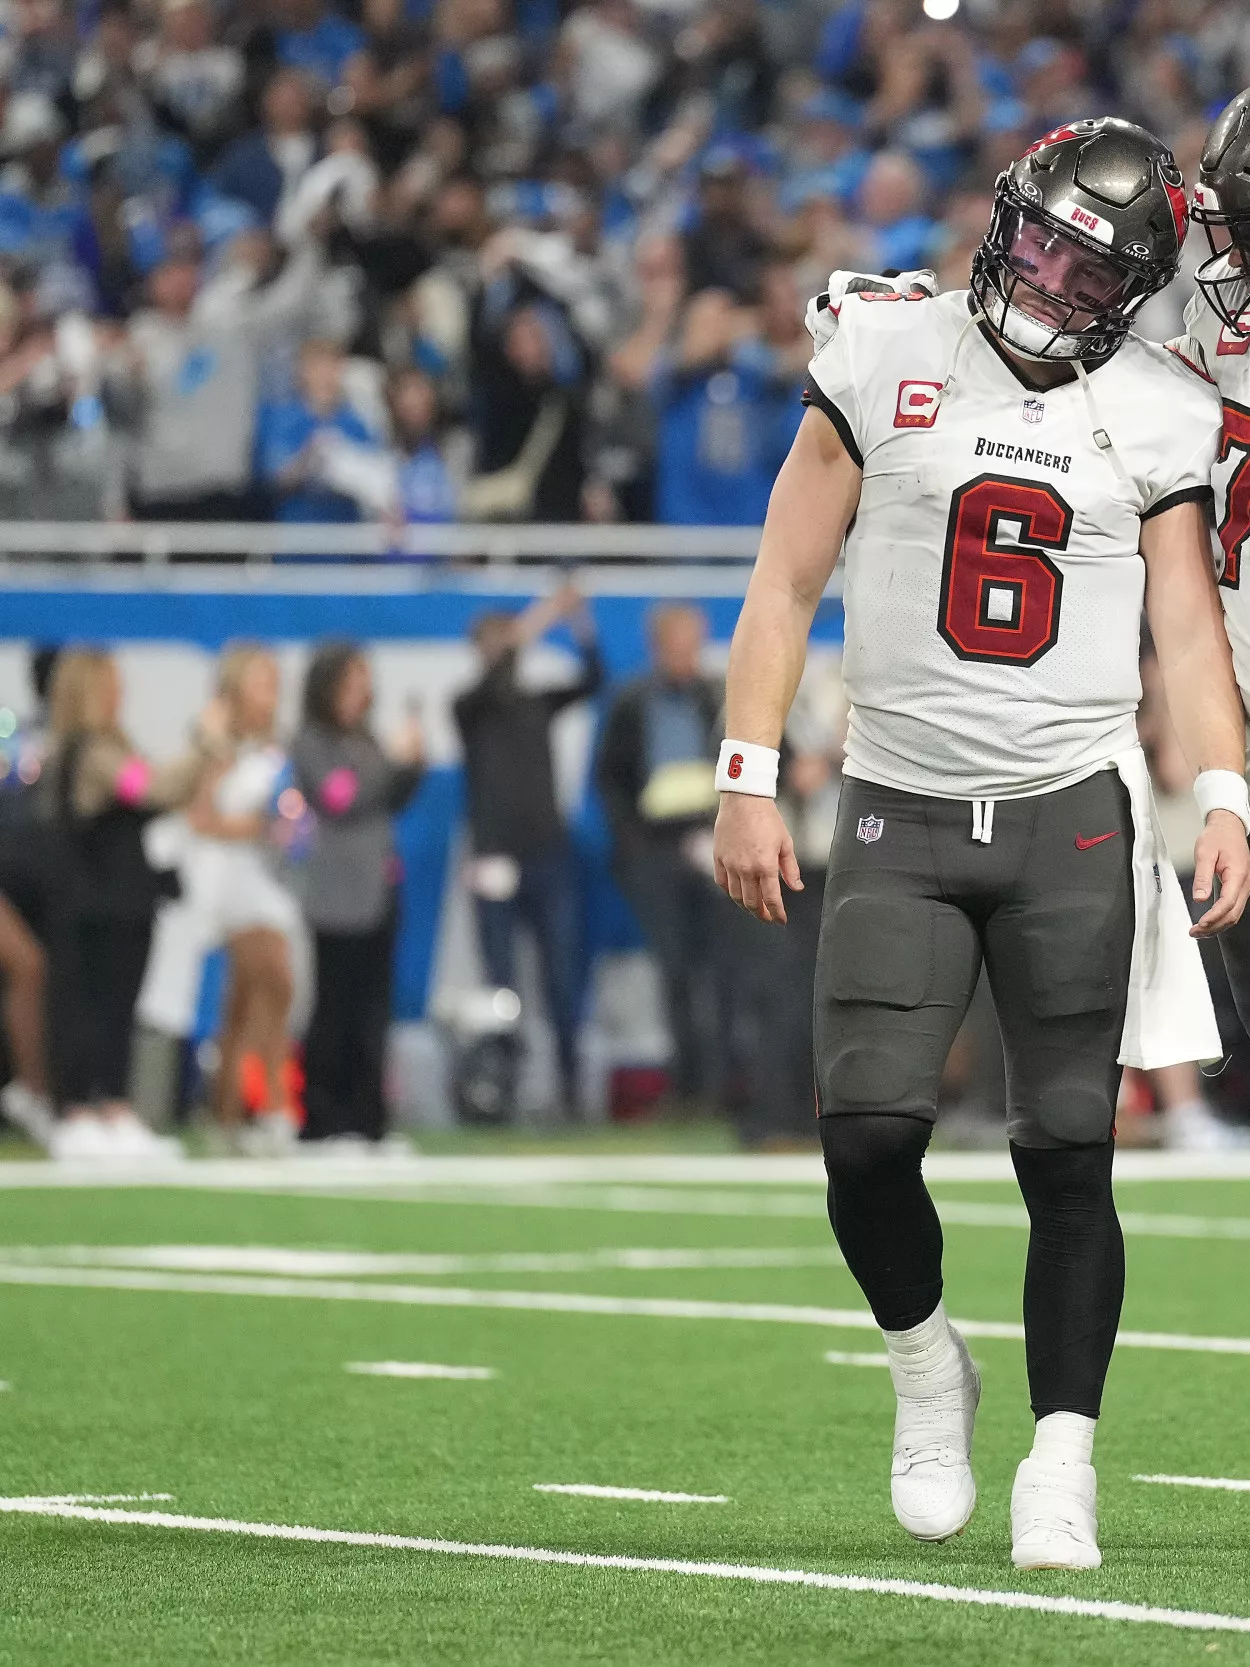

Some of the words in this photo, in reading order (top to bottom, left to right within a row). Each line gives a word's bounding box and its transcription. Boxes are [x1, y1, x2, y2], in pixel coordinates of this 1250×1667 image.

[1070, 206, 1099, 231] BUCS
[1124, 248, 1150, 261] OAKLEY
[899, 384, 940, 416] C
[974, 436, 1072, 474] BUCCANEERS
[937, 472, 1074, 669] 6
[727, 753, 744, 780] 6
[860, 827, 880, 840] NFL
